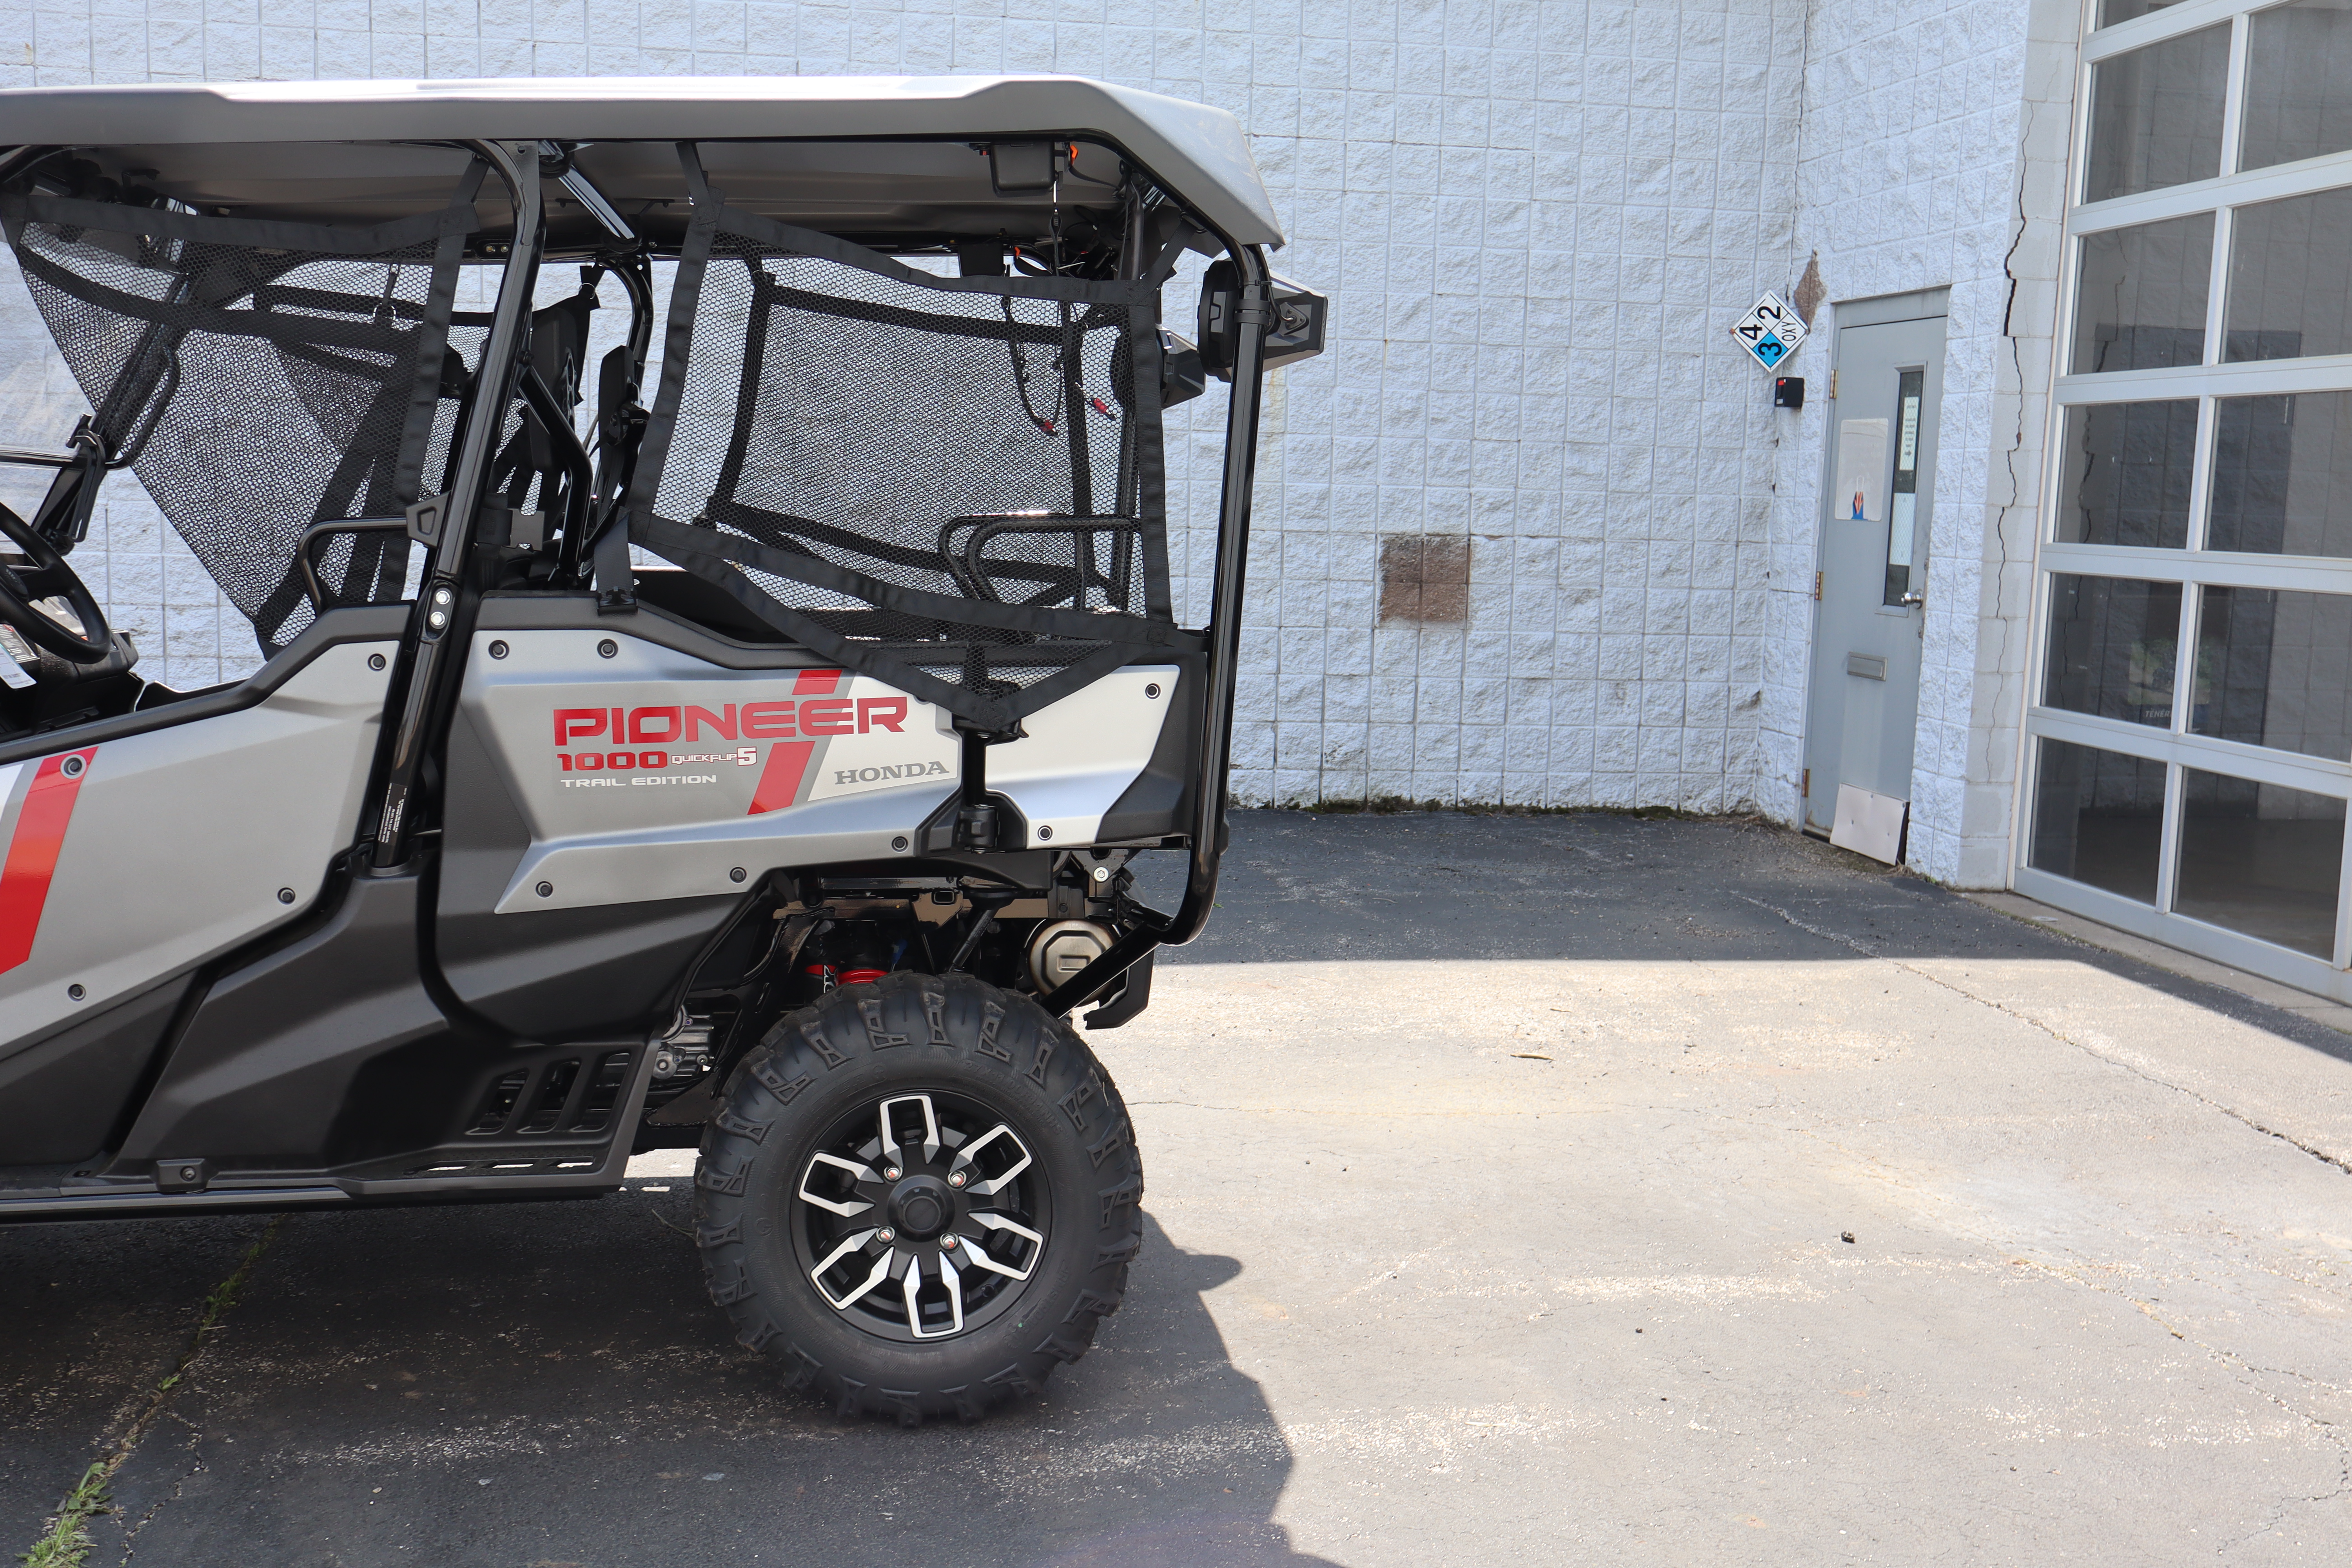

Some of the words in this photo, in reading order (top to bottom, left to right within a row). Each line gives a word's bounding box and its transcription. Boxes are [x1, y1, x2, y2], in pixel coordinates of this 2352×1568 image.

[1757, 305, 1781, 320] 2
[1739, 324, 1763, 341] 4
[1781, 321, 1797, 341] OXY
[1758, 342, 1782, 356] 3
[554, 697, 908, 746] PIONEER
[2145, 708, 2172, 718] TÉNÉR
[557, 751, 667, 771] 1000
[561, 777, 626, 788] TRAIL
[632, 775, 717, 786] EDITION
[835, 761, 949, 785] HONDA
